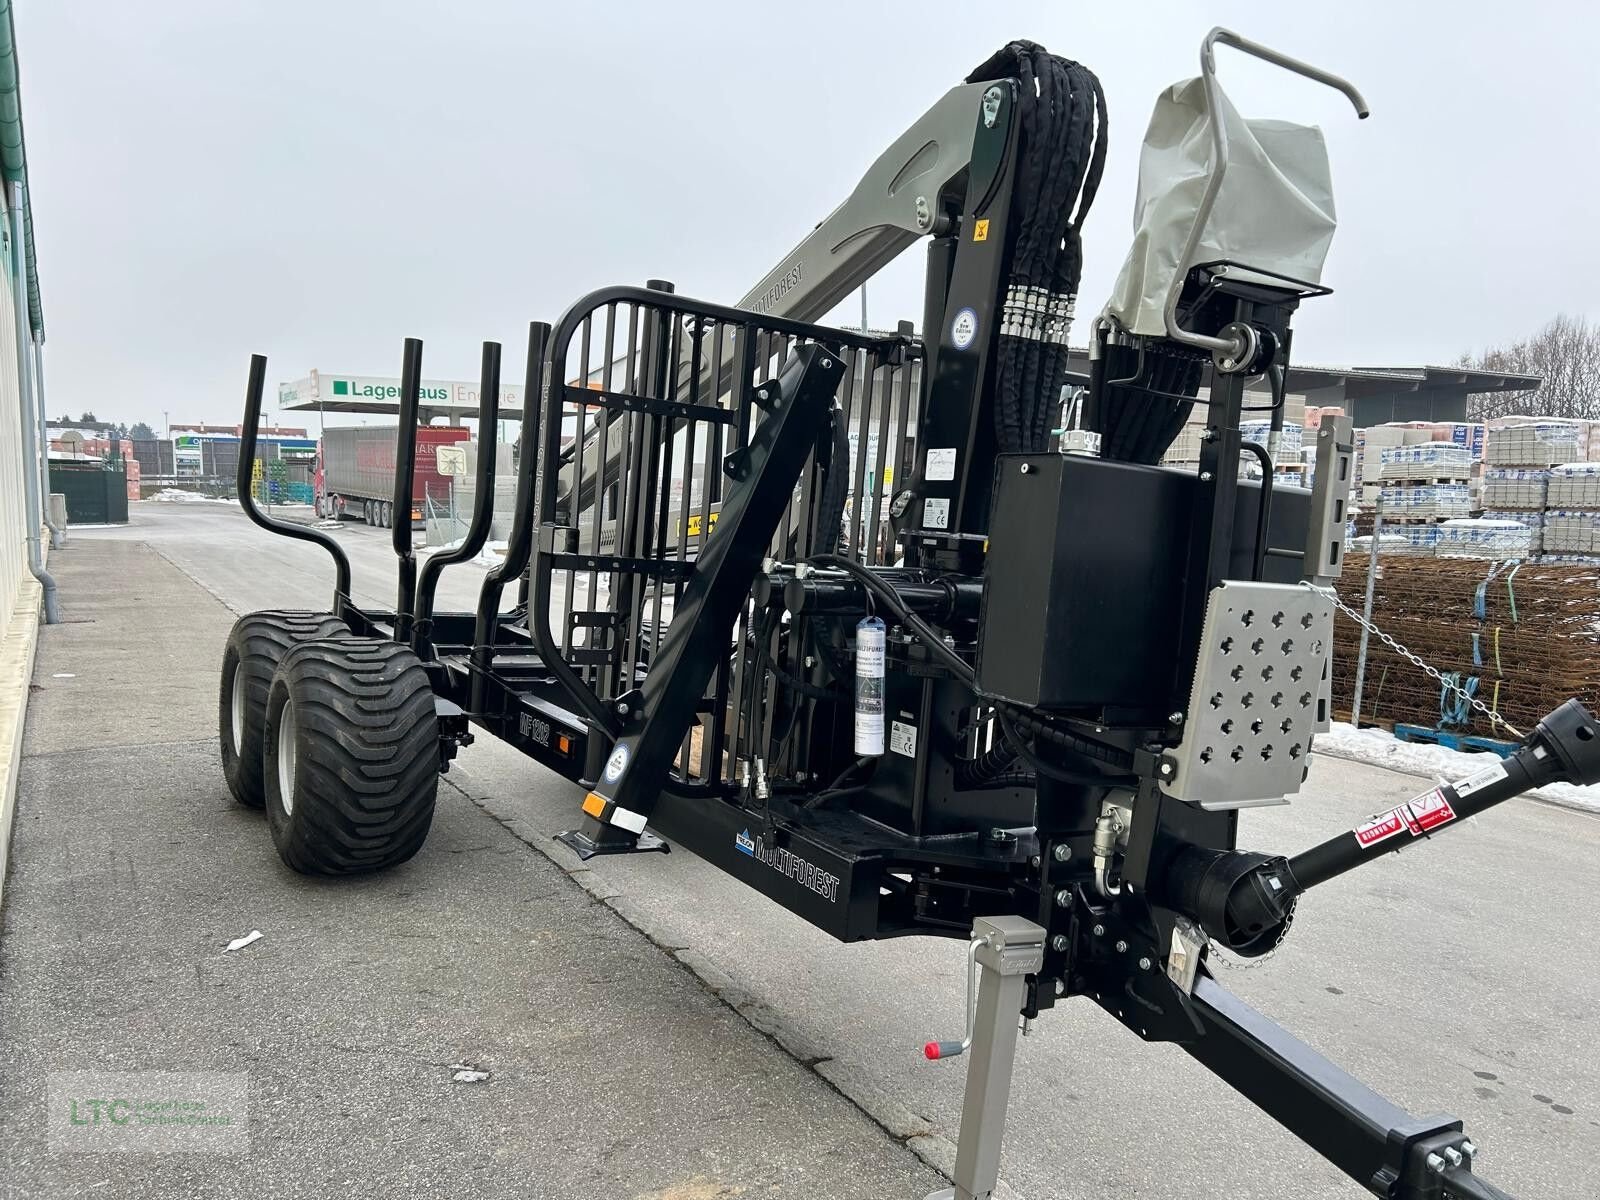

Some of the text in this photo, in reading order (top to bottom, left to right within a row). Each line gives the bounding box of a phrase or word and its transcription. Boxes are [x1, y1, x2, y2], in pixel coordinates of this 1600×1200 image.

[352, 381, 516, 406] Lageraus Enie
[532, 718, 550, 748] 1202
[755, 835, 840, 903] MULTIFOREST
